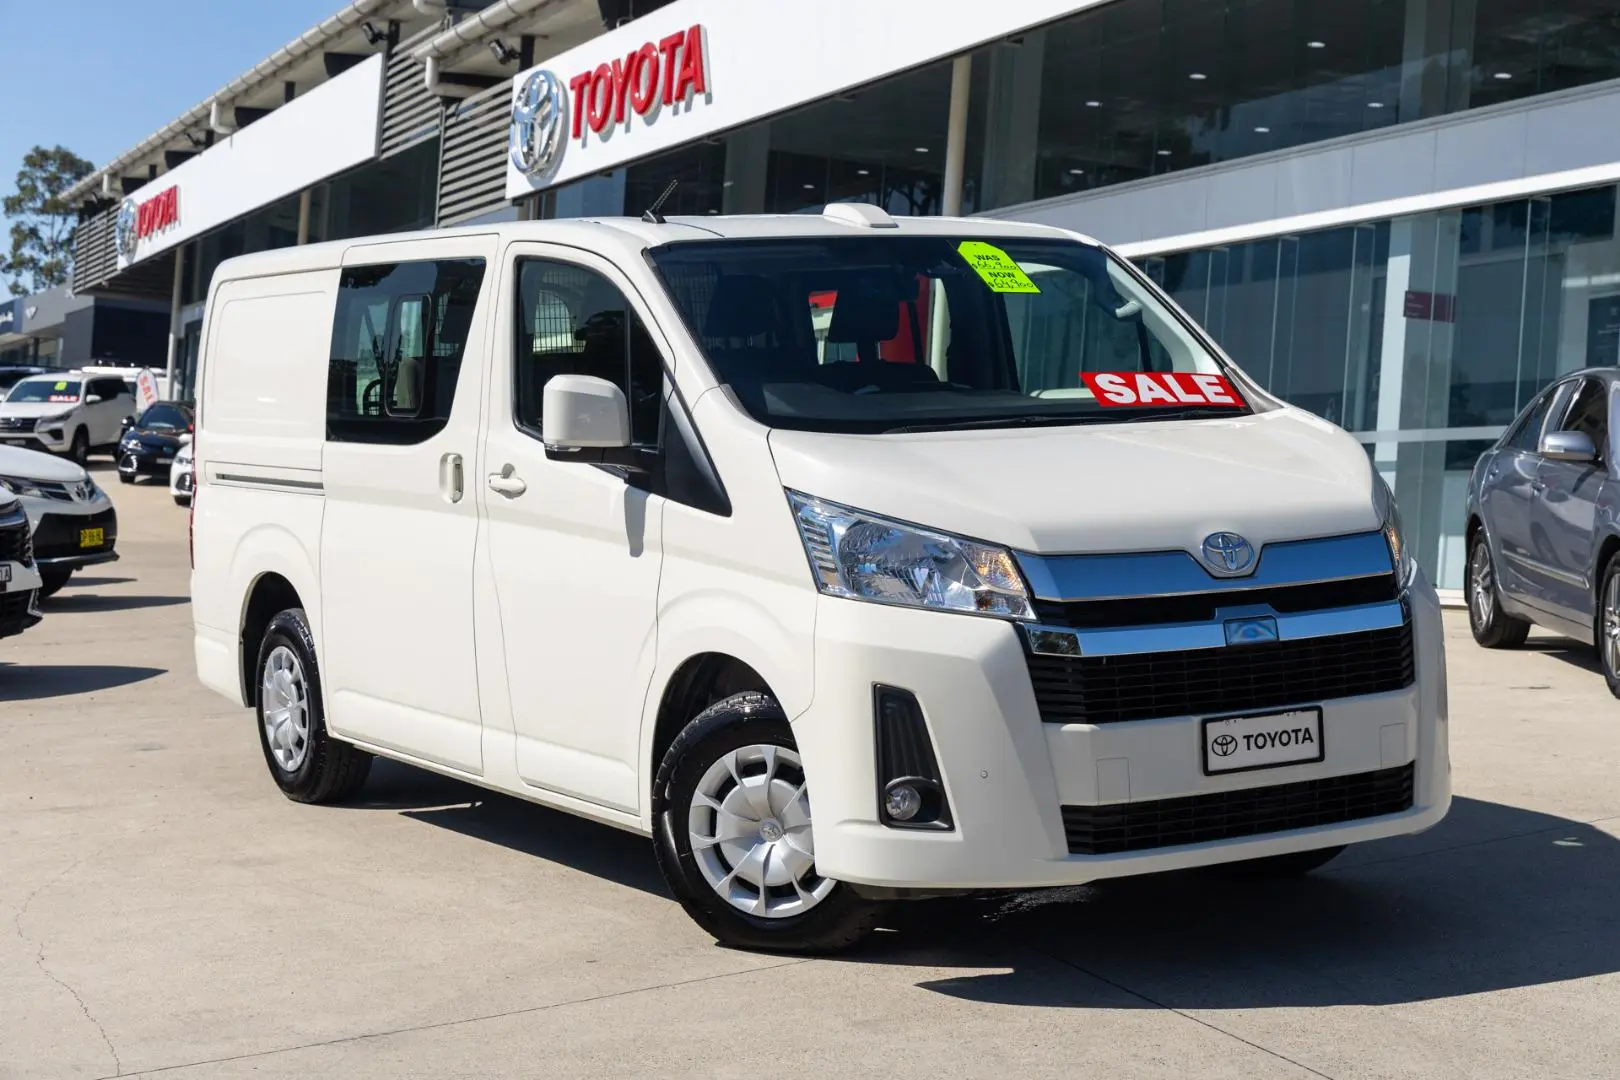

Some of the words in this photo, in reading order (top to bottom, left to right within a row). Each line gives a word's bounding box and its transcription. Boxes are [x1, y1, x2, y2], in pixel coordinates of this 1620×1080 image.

[570, 24, 705, 140] TOYOTA
[137, 184, 178, 240] TOYOTA
[988, 271, 1016, 279] NOW
[1094, 373, 1235, 404] SALE
[1243, 727, 1314, 751] TOYOTA
